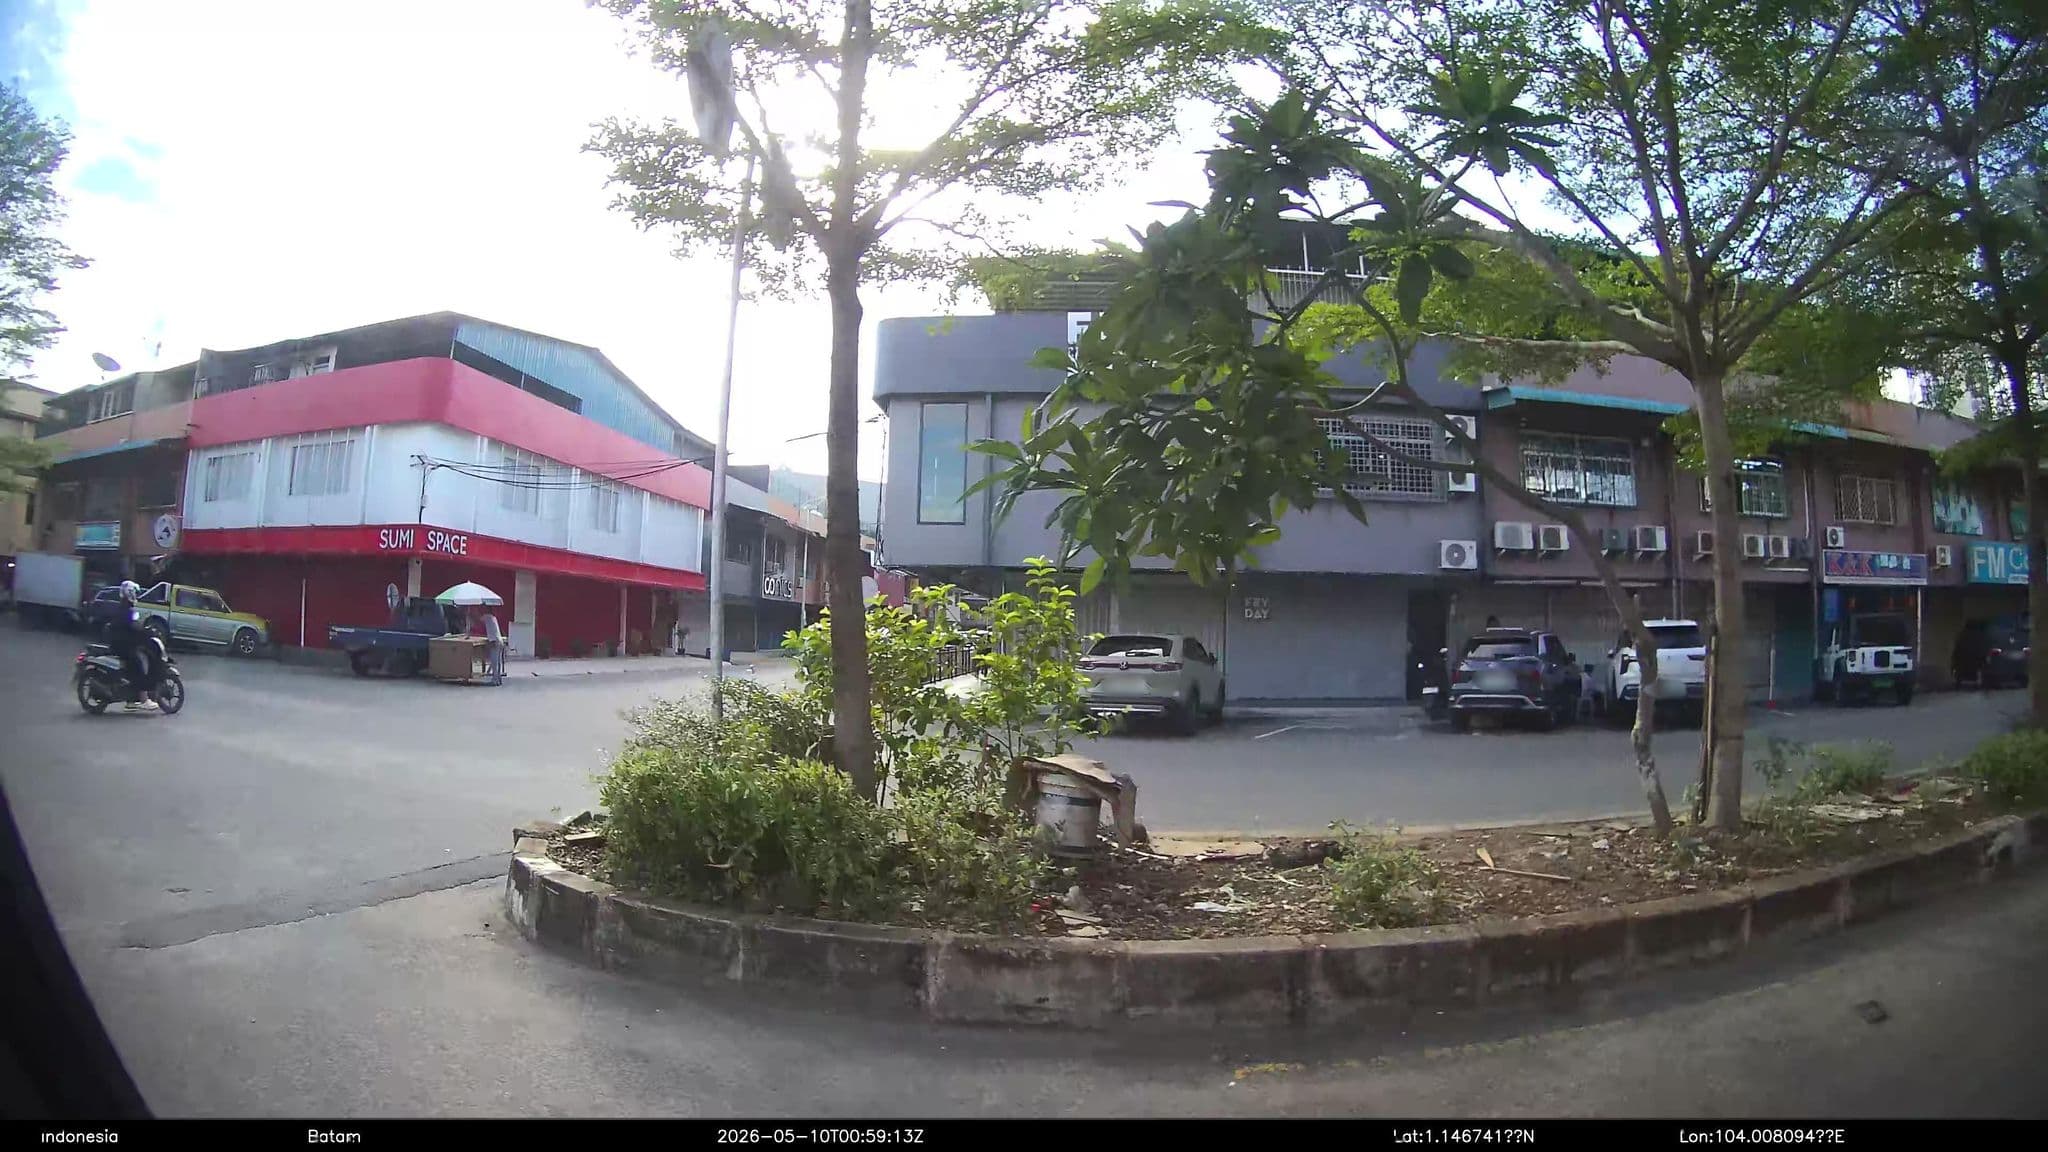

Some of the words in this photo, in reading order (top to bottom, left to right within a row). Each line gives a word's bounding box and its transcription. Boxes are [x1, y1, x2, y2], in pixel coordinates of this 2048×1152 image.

[379, 529, 414, 549] SUMI
[427, 530, 468, 555] SPACE
[1974, 546, 2006, 579] FM
[1245, 608, 1269, 619] DAY
